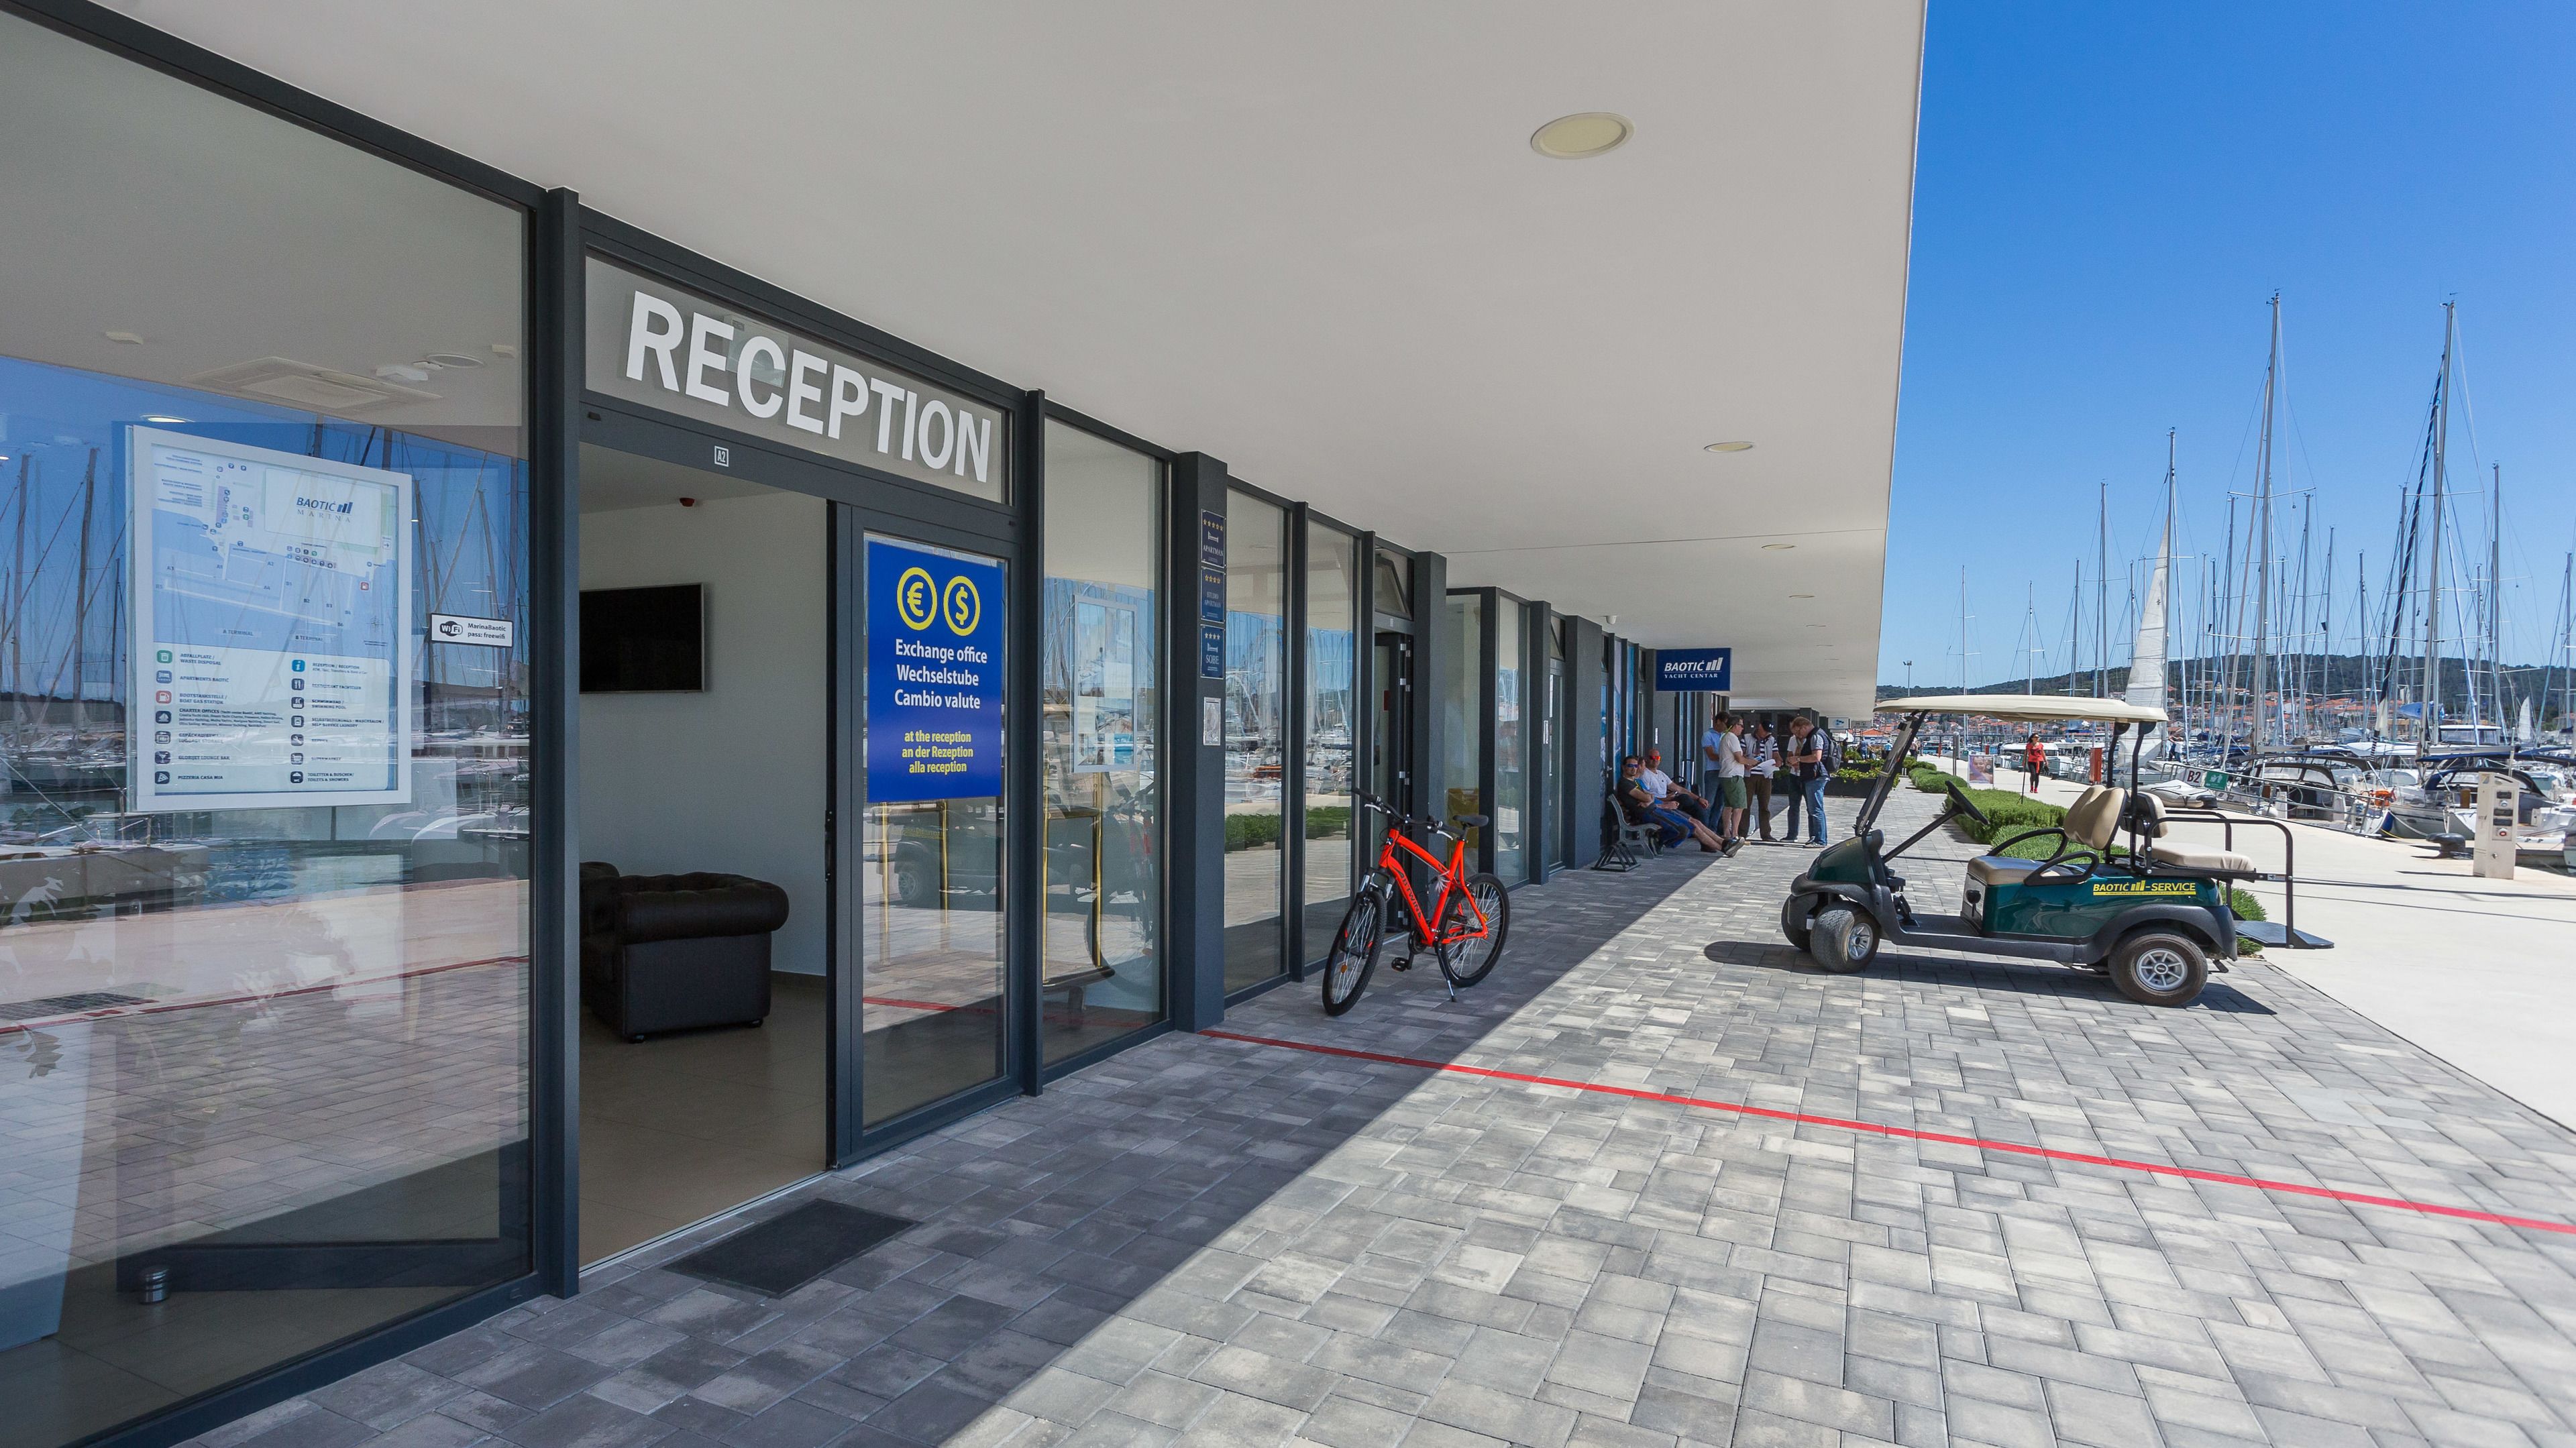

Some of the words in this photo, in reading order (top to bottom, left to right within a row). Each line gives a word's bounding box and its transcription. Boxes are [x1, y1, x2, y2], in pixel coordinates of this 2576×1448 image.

[626, 290, 991, 483] RECEPTION
[718, 450, 726, 463] A2
[296, 497, 336, 512] BAOTIĆ
[297, 509, 351, 522] MARINA
[1203, 545, 1224, 557] APARTMAN
[468, 623, 506, 631] MarinaBaotic
[896, 638, 954, 664] Exchange
[957, 646, 987, 664] office
[1205, 655, 1220, 665] SOBE
[1664, 660, 1705, 671] BAOTIĆ
[896, 664, 979, 687] Wechselstube
[894, 689, 942, 708] Cambio
[945, 693, 981, 709] valute
[904, 730, 914, 742] at
[915, 730, 930, 742] the
[931, 732, 971, 745] reception
[902, 749, 914, 758] an
[914, 746, 930, 759] der
[931, 746, 973, 760] Rezeption
[909, 761, 926, 773] alla
[926, 761, 967, 775] reception
[2187, 770, 2200, 783] B2
[2093, 882, 2129, 891] BAOTIĆ
